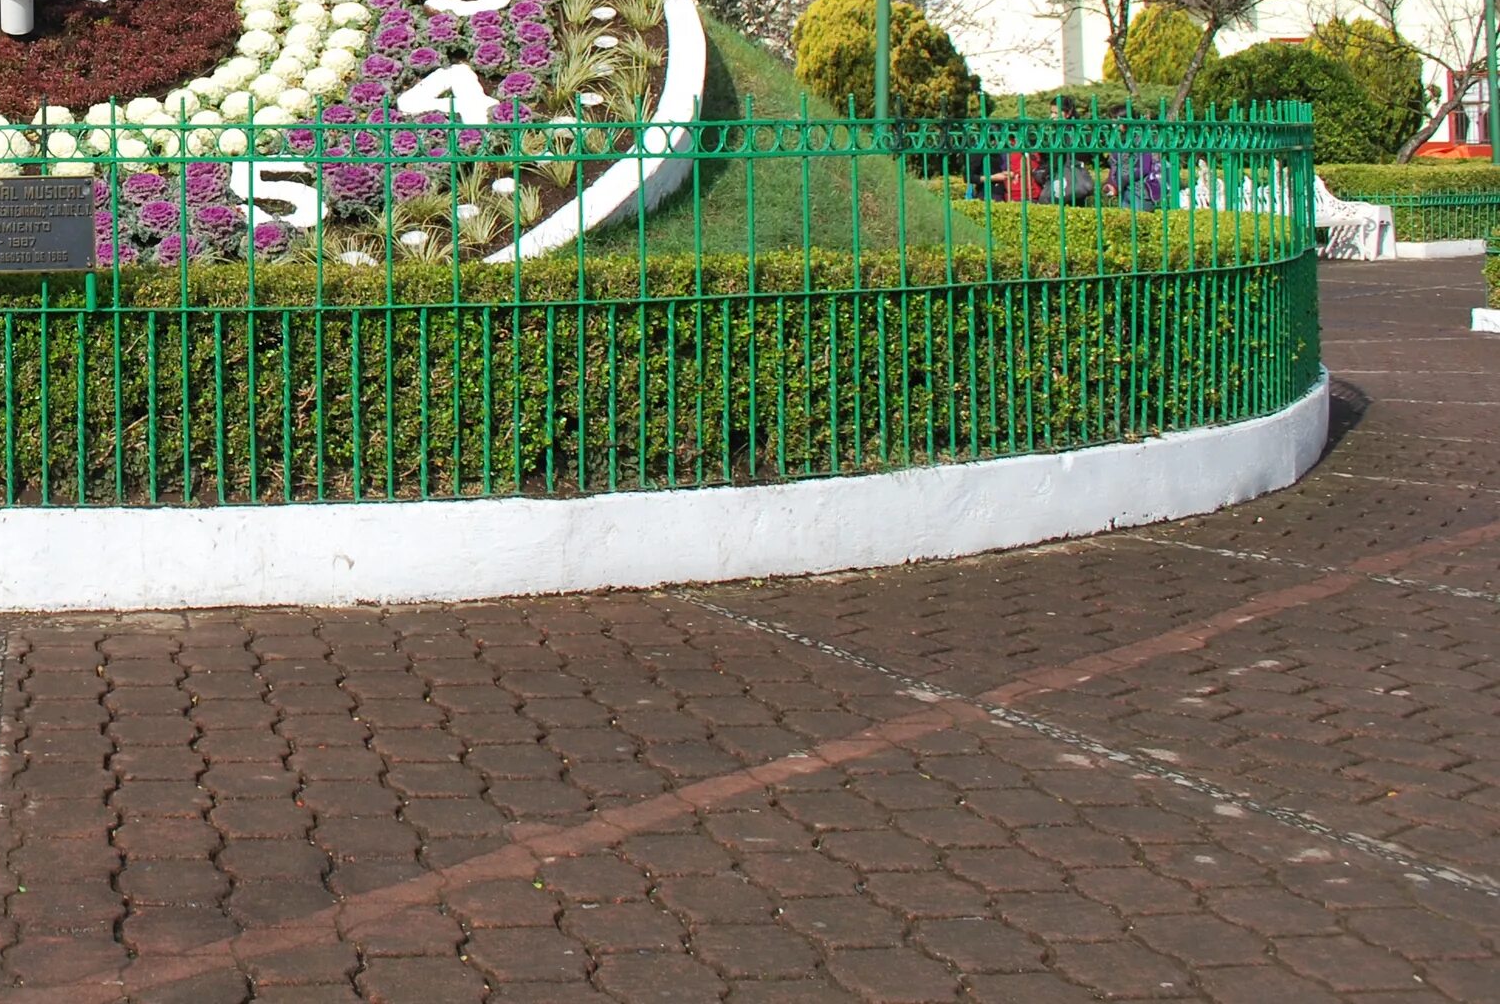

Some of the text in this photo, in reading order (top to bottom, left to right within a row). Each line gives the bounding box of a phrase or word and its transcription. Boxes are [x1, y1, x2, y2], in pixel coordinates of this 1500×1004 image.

[397, 64, 499, 132] 4
[23, 184, 86, 200] MUSICAL
[229, 156, 328, 230] 5
[8, 237, 37, 249] 1987
[35, 252, 46, 262] DE
